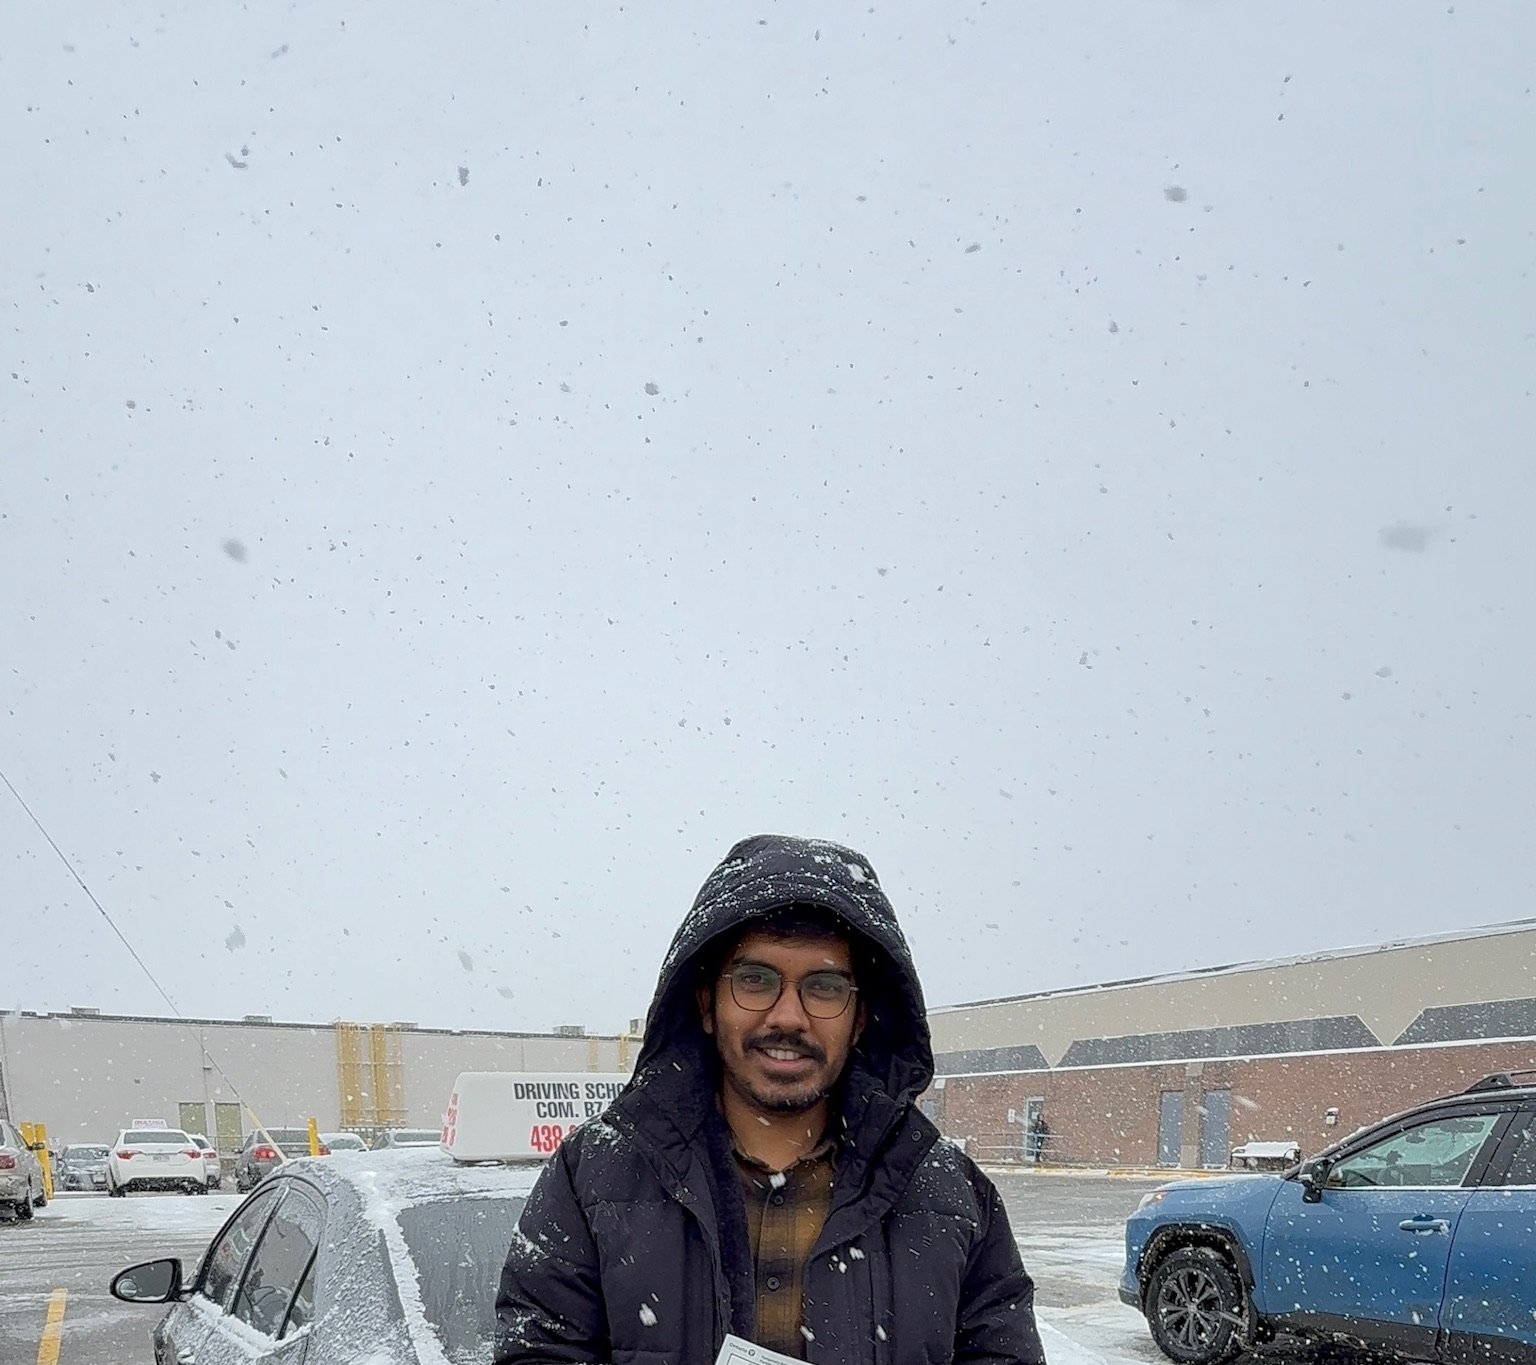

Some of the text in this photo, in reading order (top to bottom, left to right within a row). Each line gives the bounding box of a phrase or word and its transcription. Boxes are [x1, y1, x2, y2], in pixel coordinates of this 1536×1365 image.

[514, 1083, 625, 1100] DRIVING SCHO
[536, 1101, 579, 1118] COM.
[531, 1124, 562, 1152] 438
